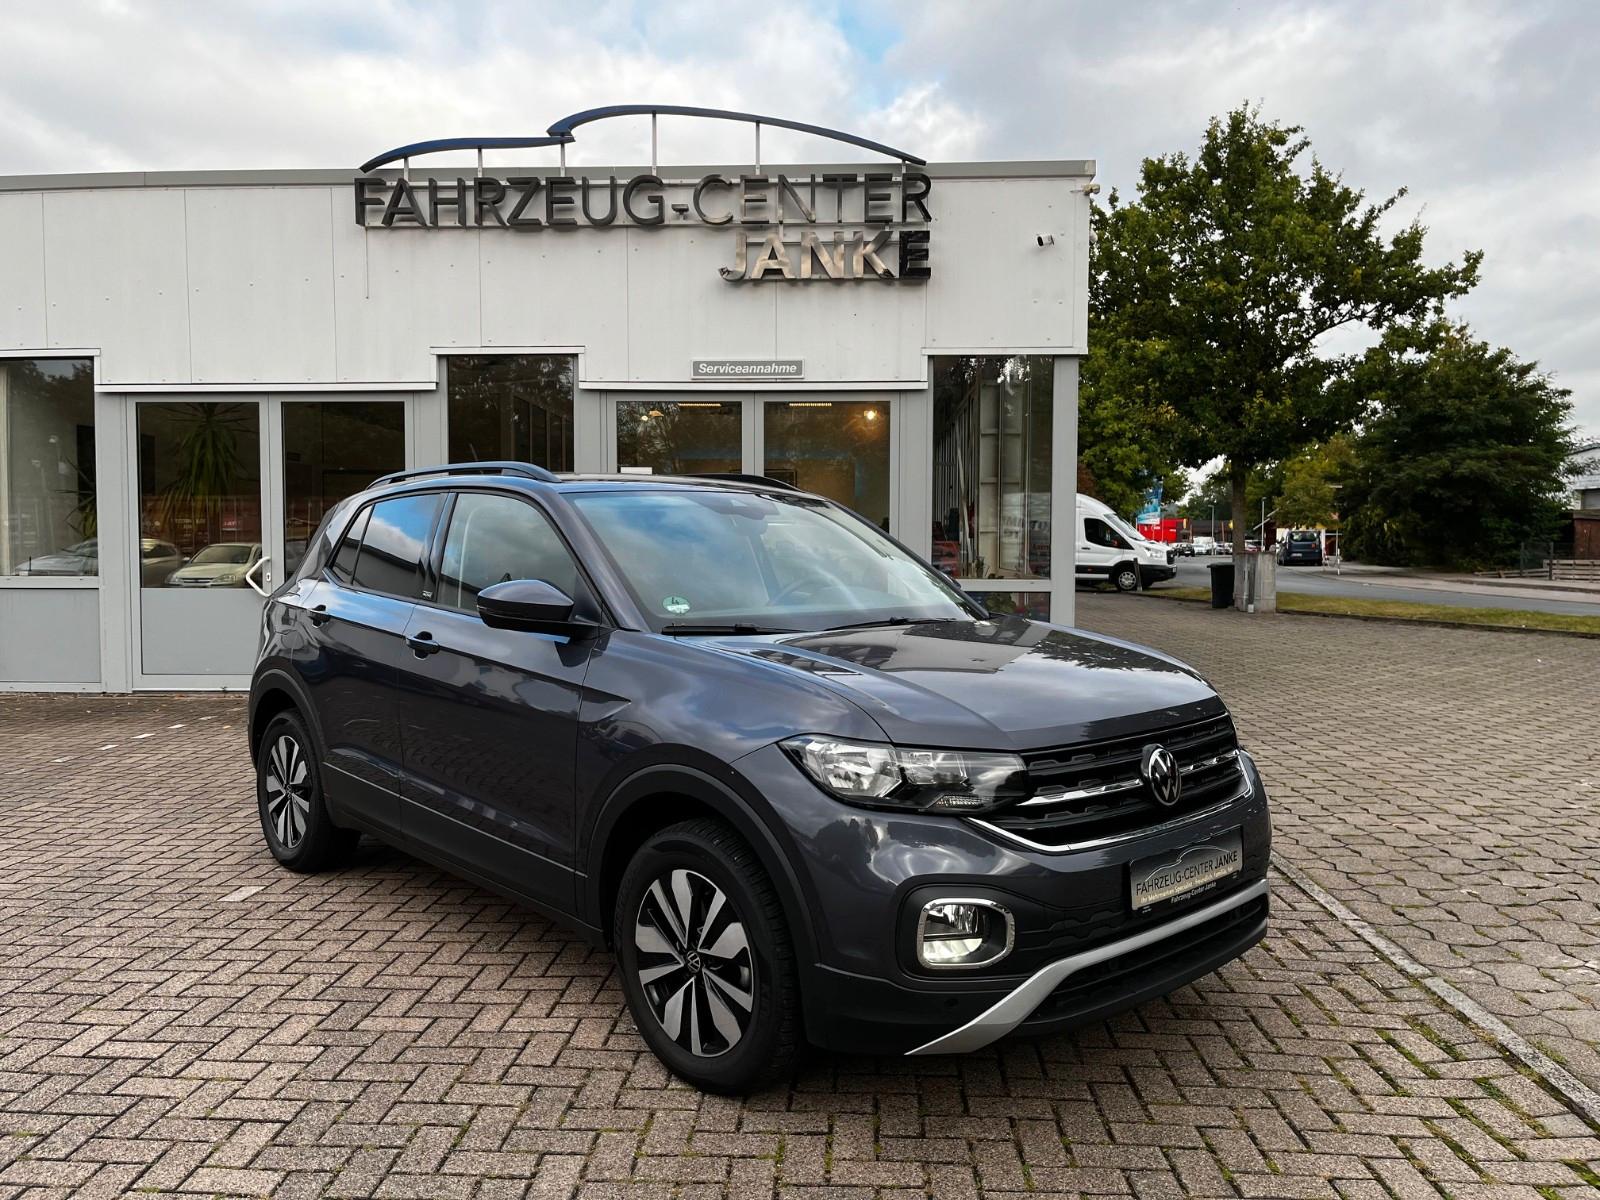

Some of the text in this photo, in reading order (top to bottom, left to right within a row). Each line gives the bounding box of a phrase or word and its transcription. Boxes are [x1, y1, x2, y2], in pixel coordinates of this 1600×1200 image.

[354, 173, 932, 228] FAHRZEUG-CENTER
[718, 229, 932, 283] JANKE
[698, 362, 798, 374] Serviceannahme
[1136, 859, 1213, 896] FAHRZEUG-CENTER
[1214, 850, 1238, 870] JANKE
